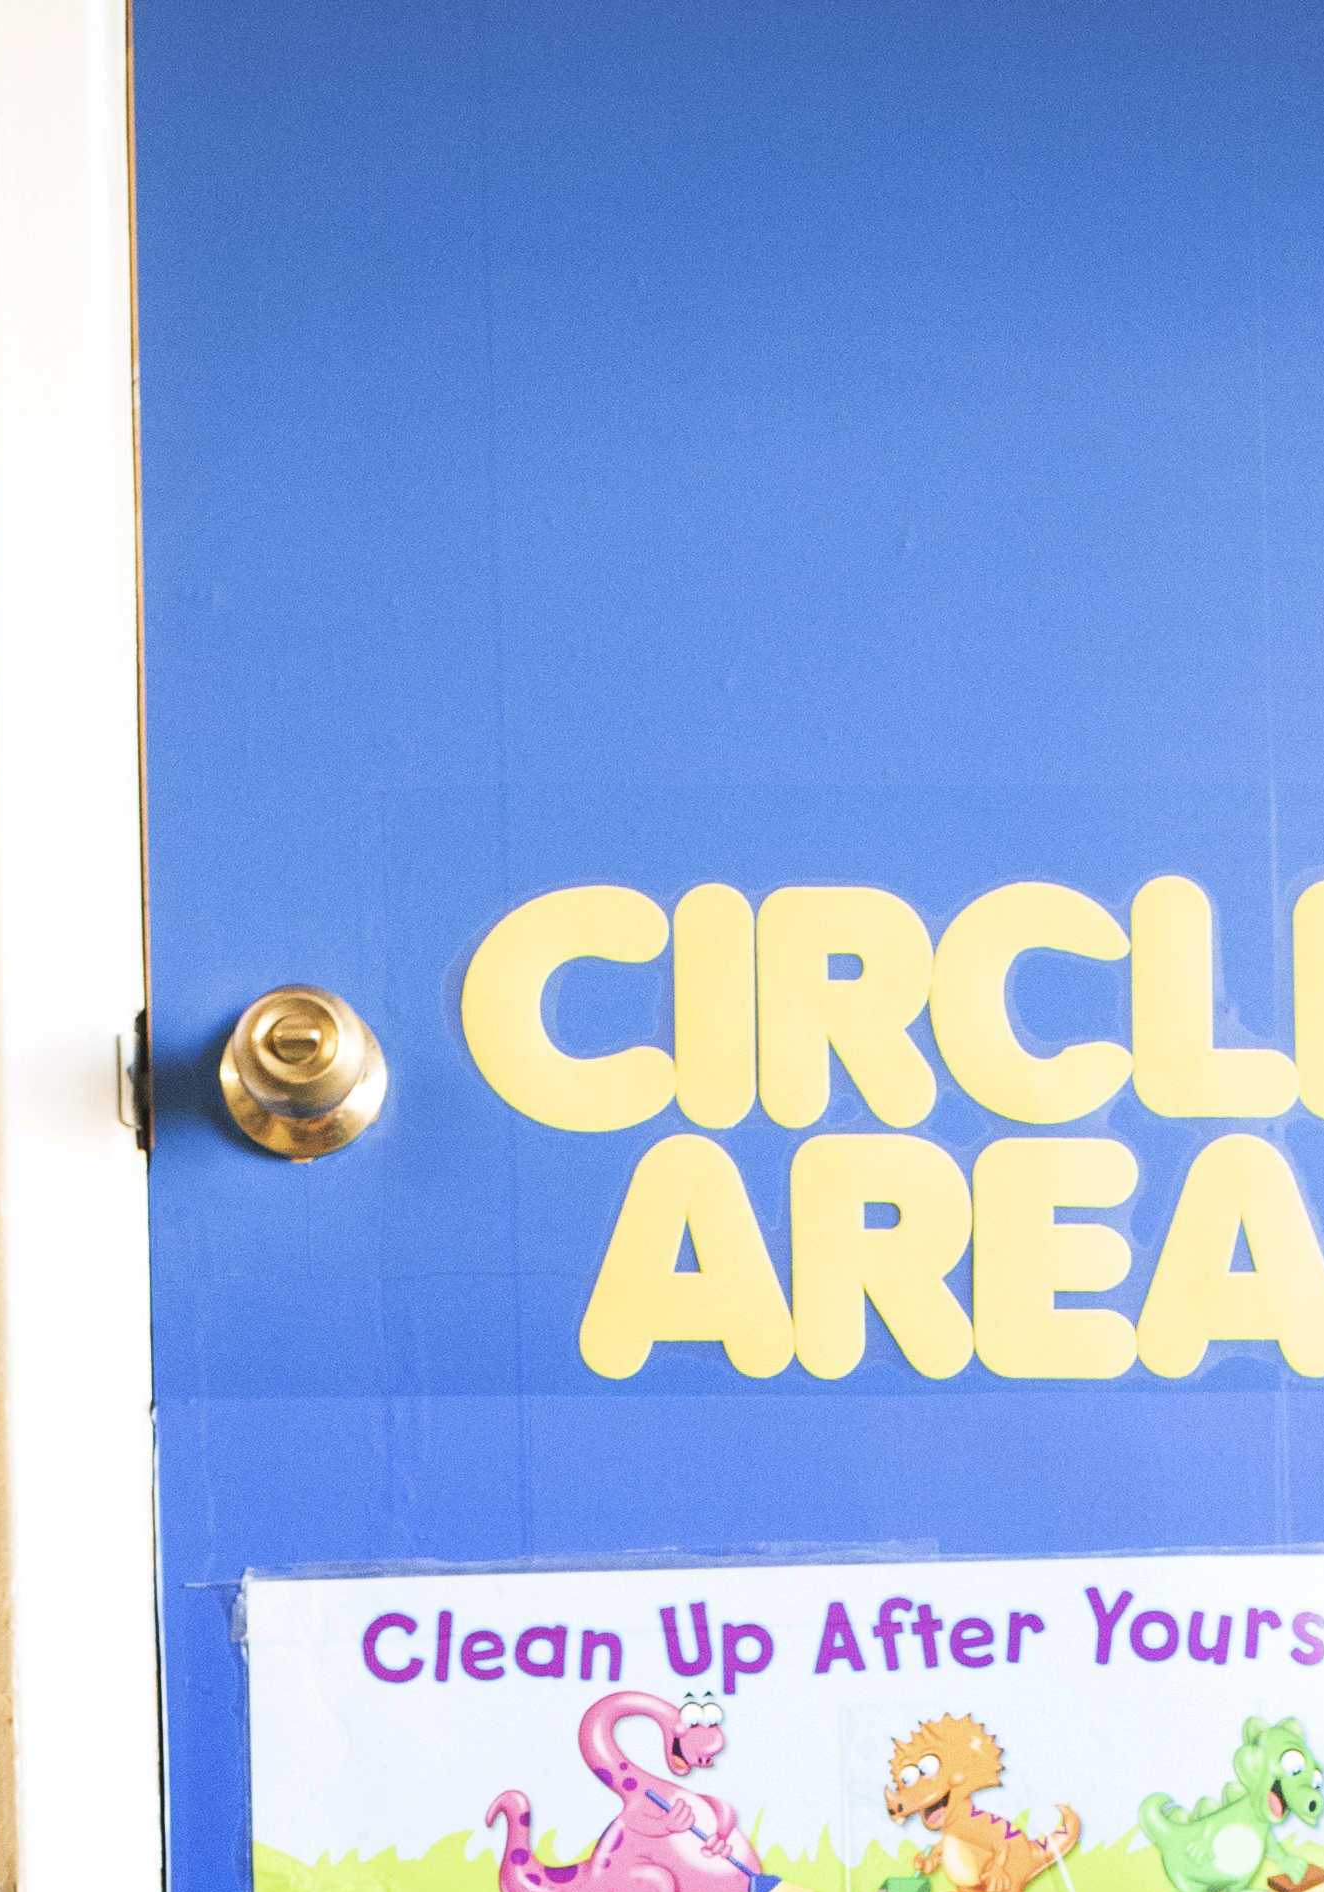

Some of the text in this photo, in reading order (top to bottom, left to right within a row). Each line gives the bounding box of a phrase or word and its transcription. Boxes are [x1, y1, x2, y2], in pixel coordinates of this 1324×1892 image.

[362, 1610, 622, 1683] Clean
[660, 1602, 774, 1695] Up
[813, 1597, 1044, 1677] After
